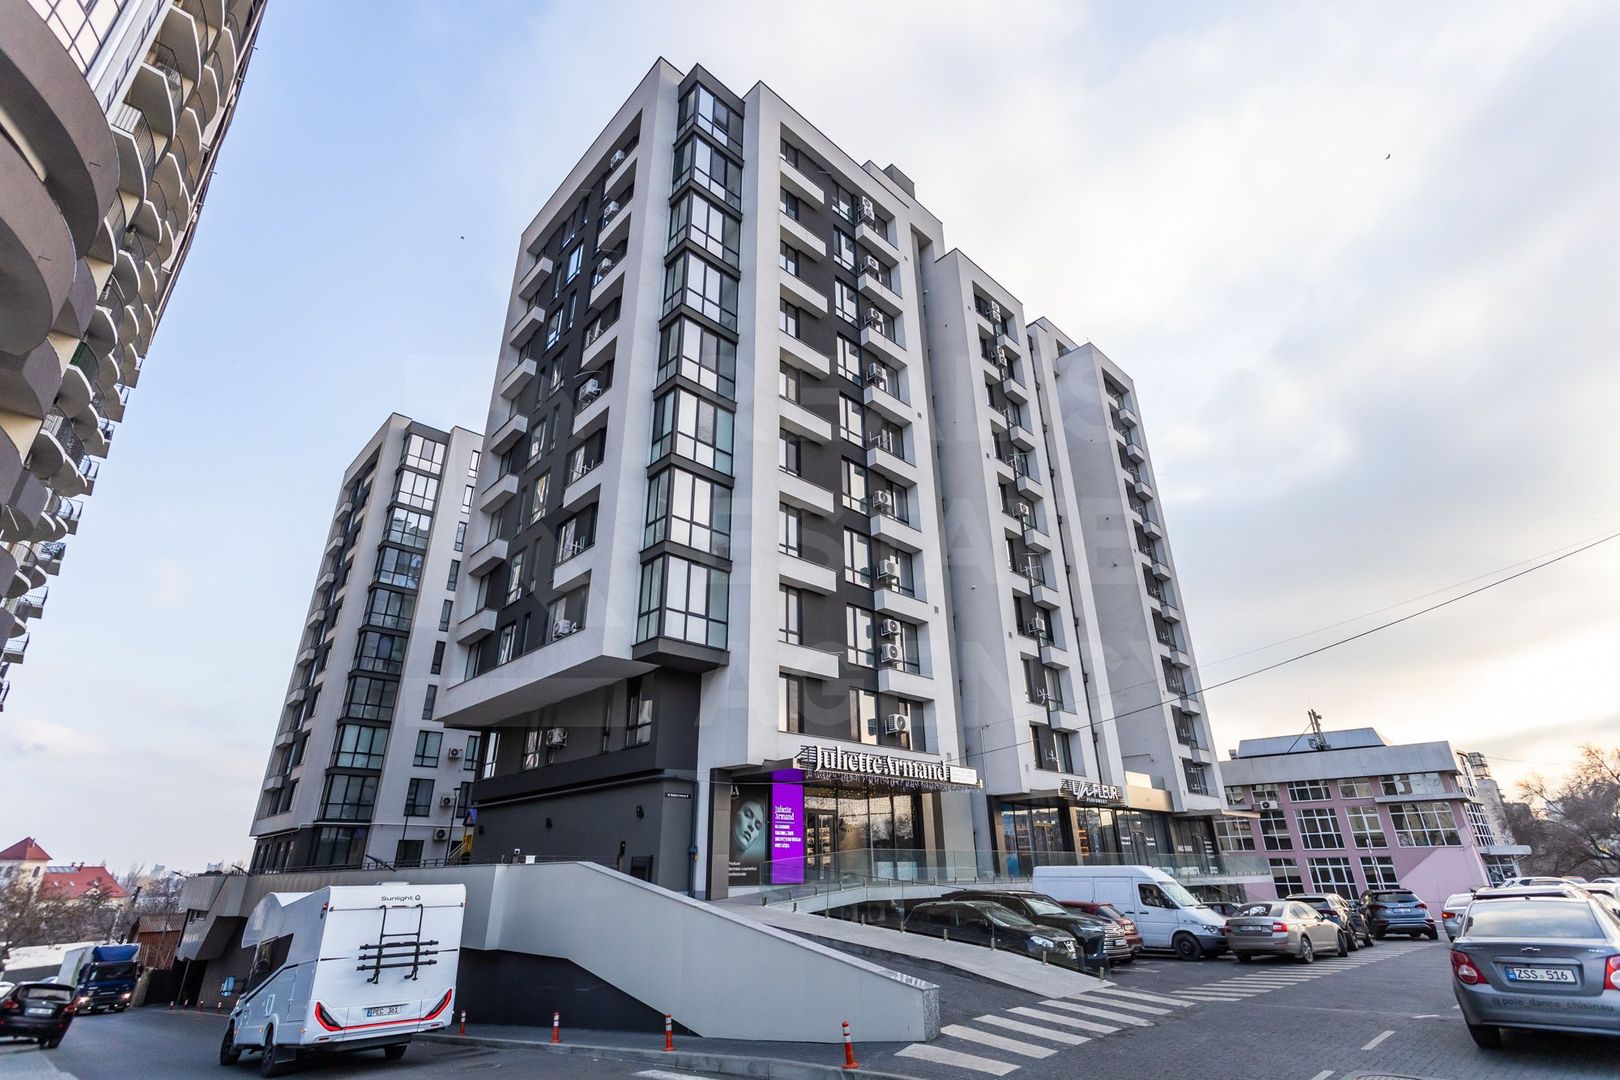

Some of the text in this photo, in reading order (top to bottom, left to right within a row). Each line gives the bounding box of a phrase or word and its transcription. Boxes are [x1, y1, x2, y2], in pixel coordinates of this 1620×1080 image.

[815, 745, 883, 775] Juliette
[884, 754, 949, 782] Armand
[1515, 969, 1538, 980] ZSS
[1545, 970, 1568, 981] 516
